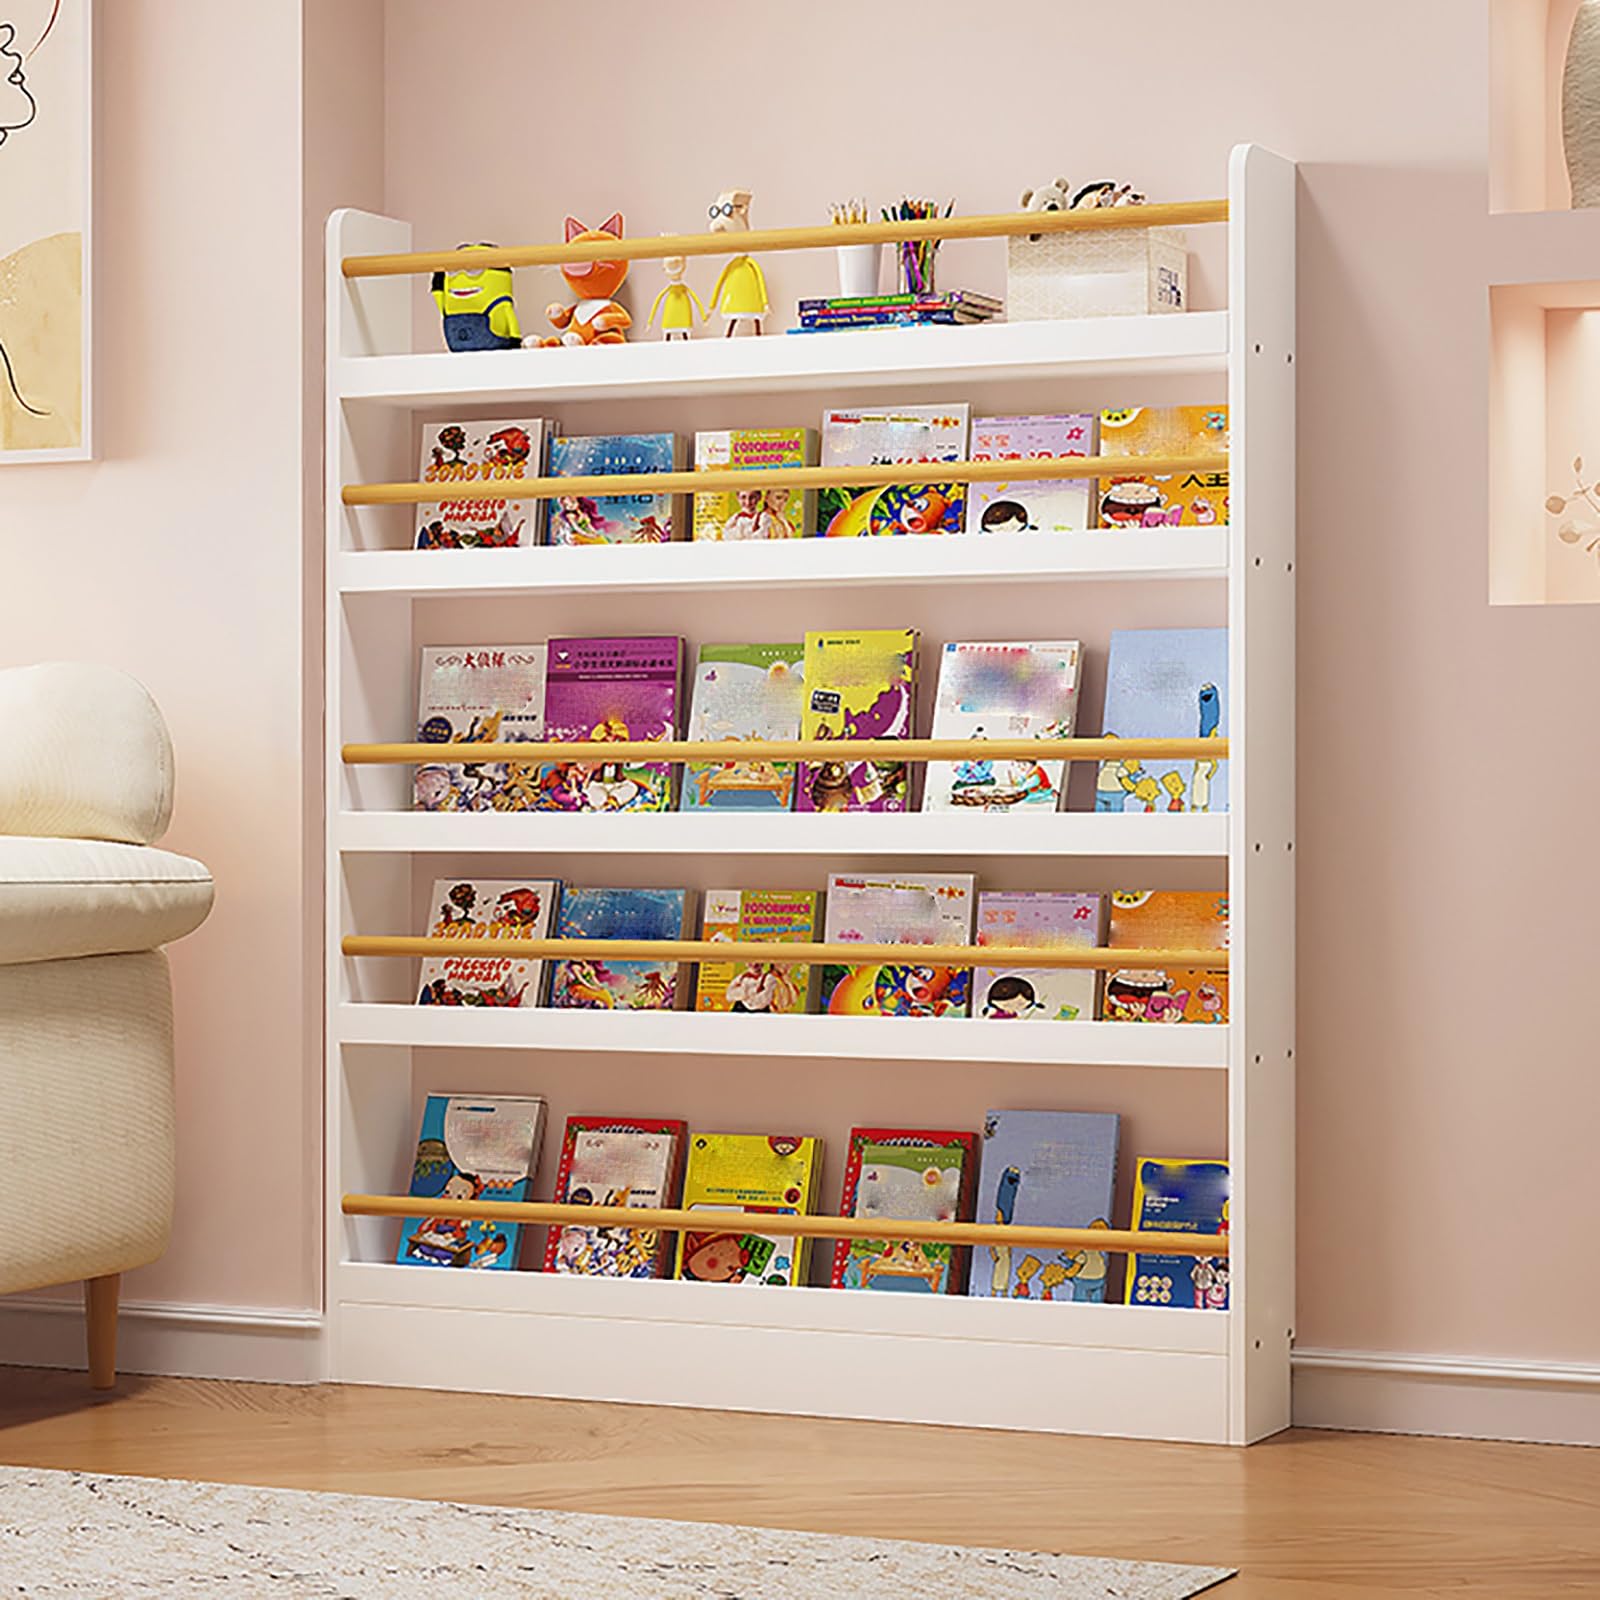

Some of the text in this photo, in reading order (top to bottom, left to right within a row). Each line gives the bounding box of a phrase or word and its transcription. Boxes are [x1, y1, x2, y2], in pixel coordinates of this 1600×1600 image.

[425, 460, 528, 482] ЗОЛОТЫЕ
[439, 499, 507, 511] РУССКОГО
[443, 511, 498, 522] НАРОДА
[432, 920, 536, 939] ЗОЛОТЫЕ
[444, 957, 511, 970] РУССКОГО
[447, 970, 502, 982] НАРОДА
